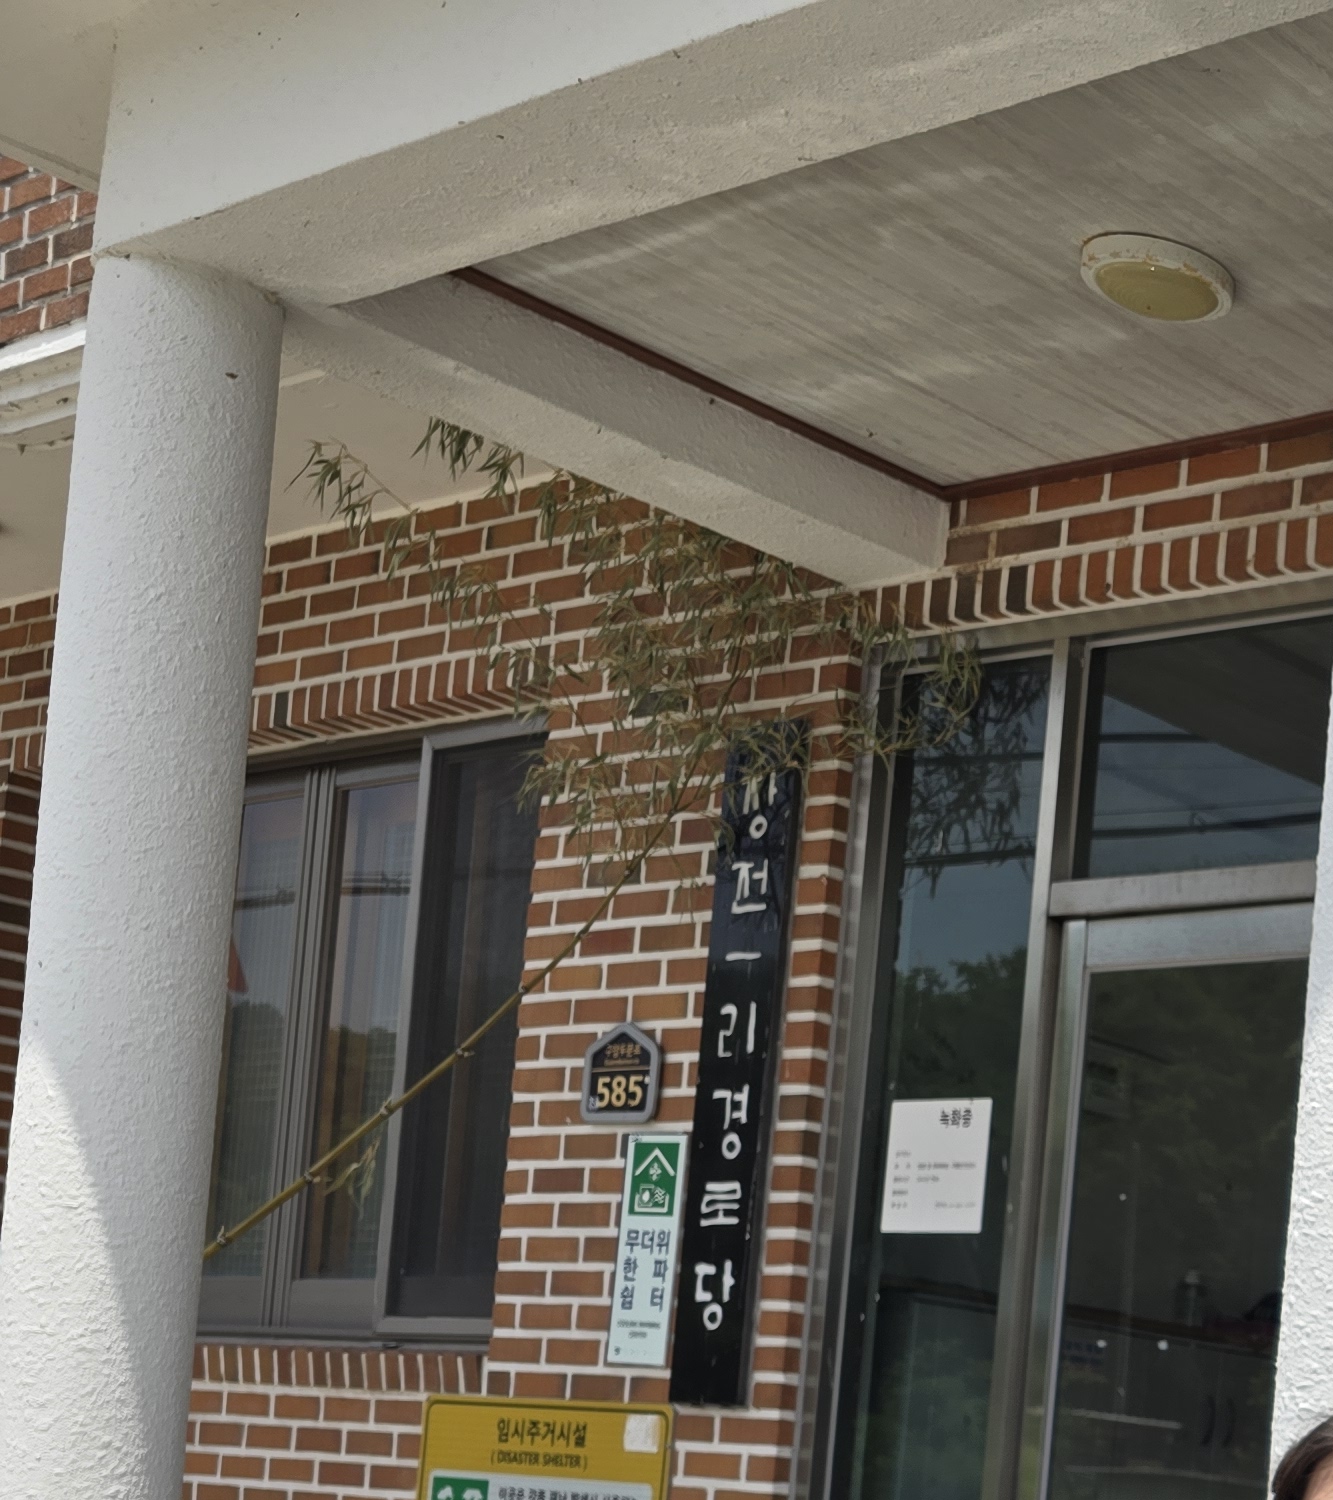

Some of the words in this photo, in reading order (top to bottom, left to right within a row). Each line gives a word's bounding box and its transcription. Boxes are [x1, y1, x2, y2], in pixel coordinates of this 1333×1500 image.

[597, 1075, 644, 1108] 585
[625, 1228, 672, 1255] 무더위
[496, 1417, 588, 1449] 임시주거시설
